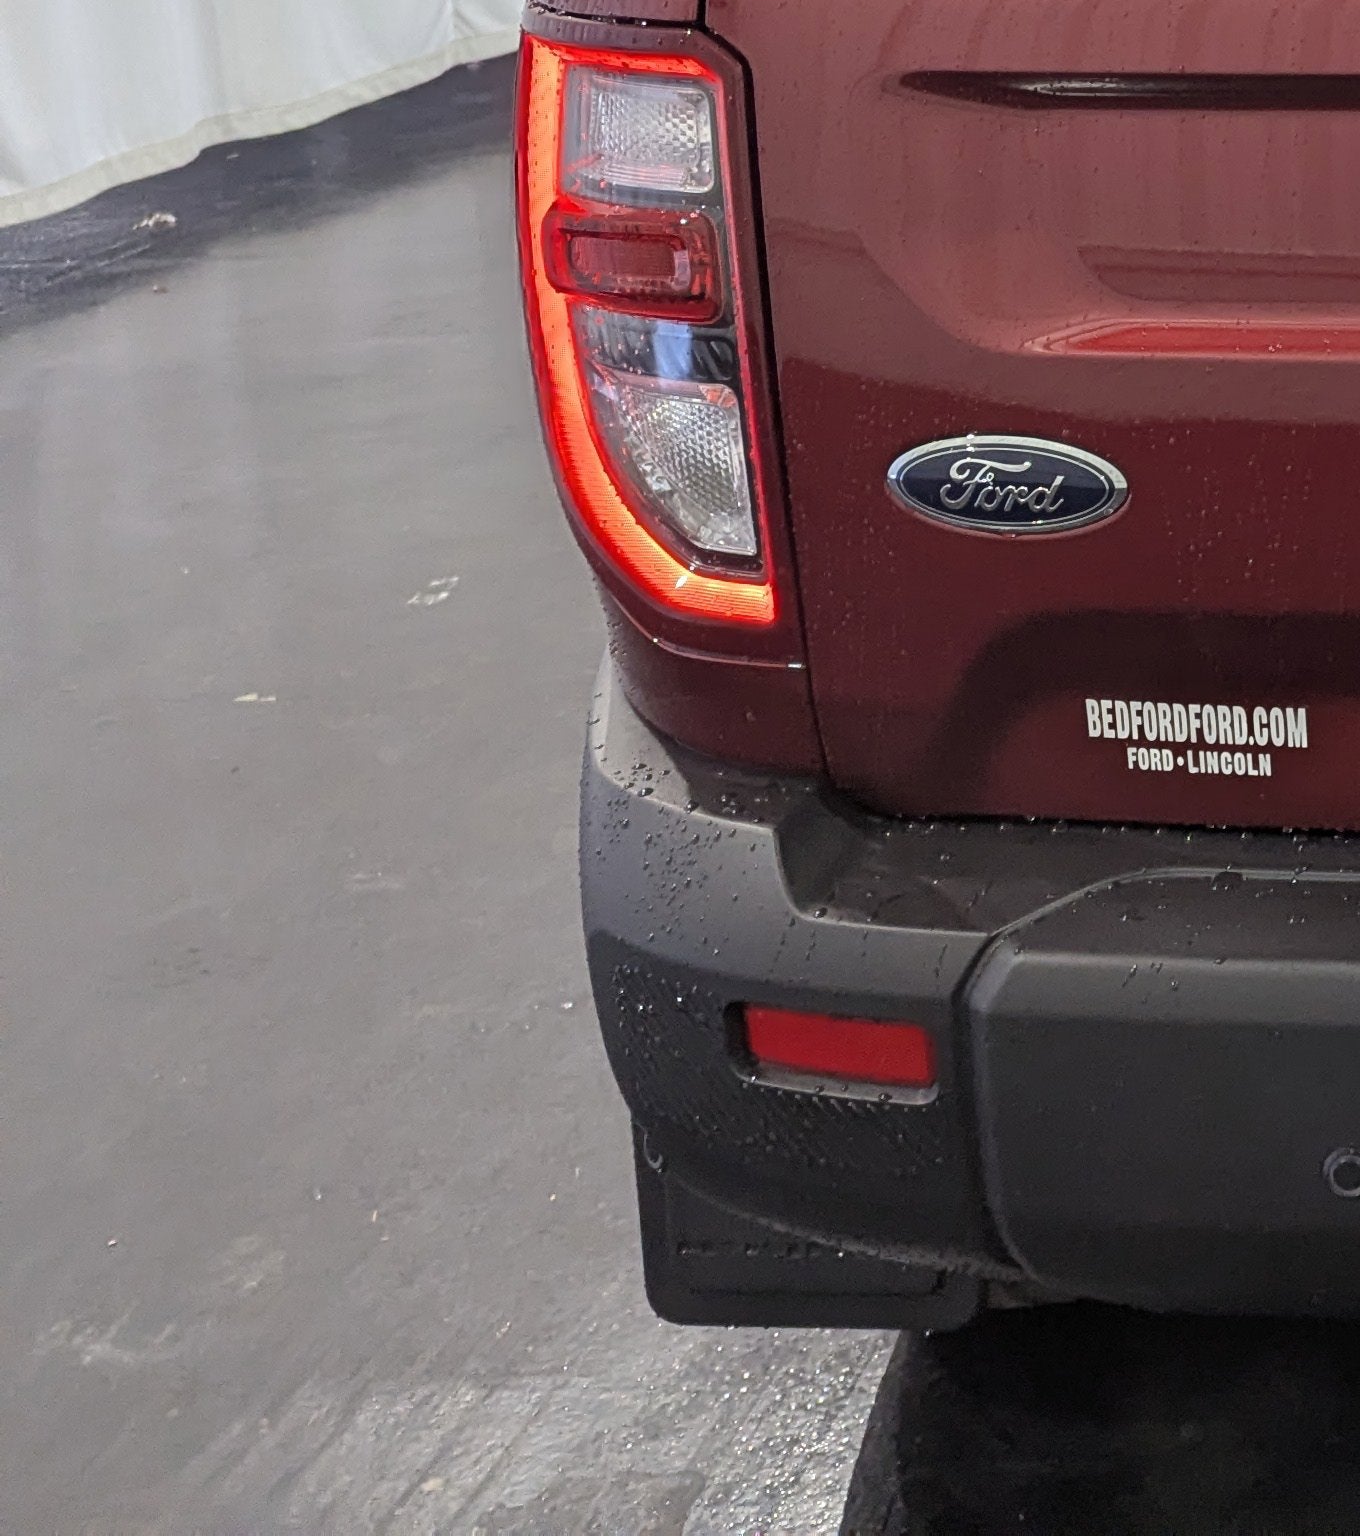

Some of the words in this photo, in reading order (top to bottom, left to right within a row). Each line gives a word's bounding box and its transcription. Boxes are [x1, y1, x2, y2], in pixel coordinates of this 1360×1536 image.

[940, 458, 1065, 512] Ford
[1085, 698, 1308, 748] BEDFORDFORD.COM
[1127, 747, 1174, 772] FORD
[1187, 750, 1272, 776] LINCOLN
